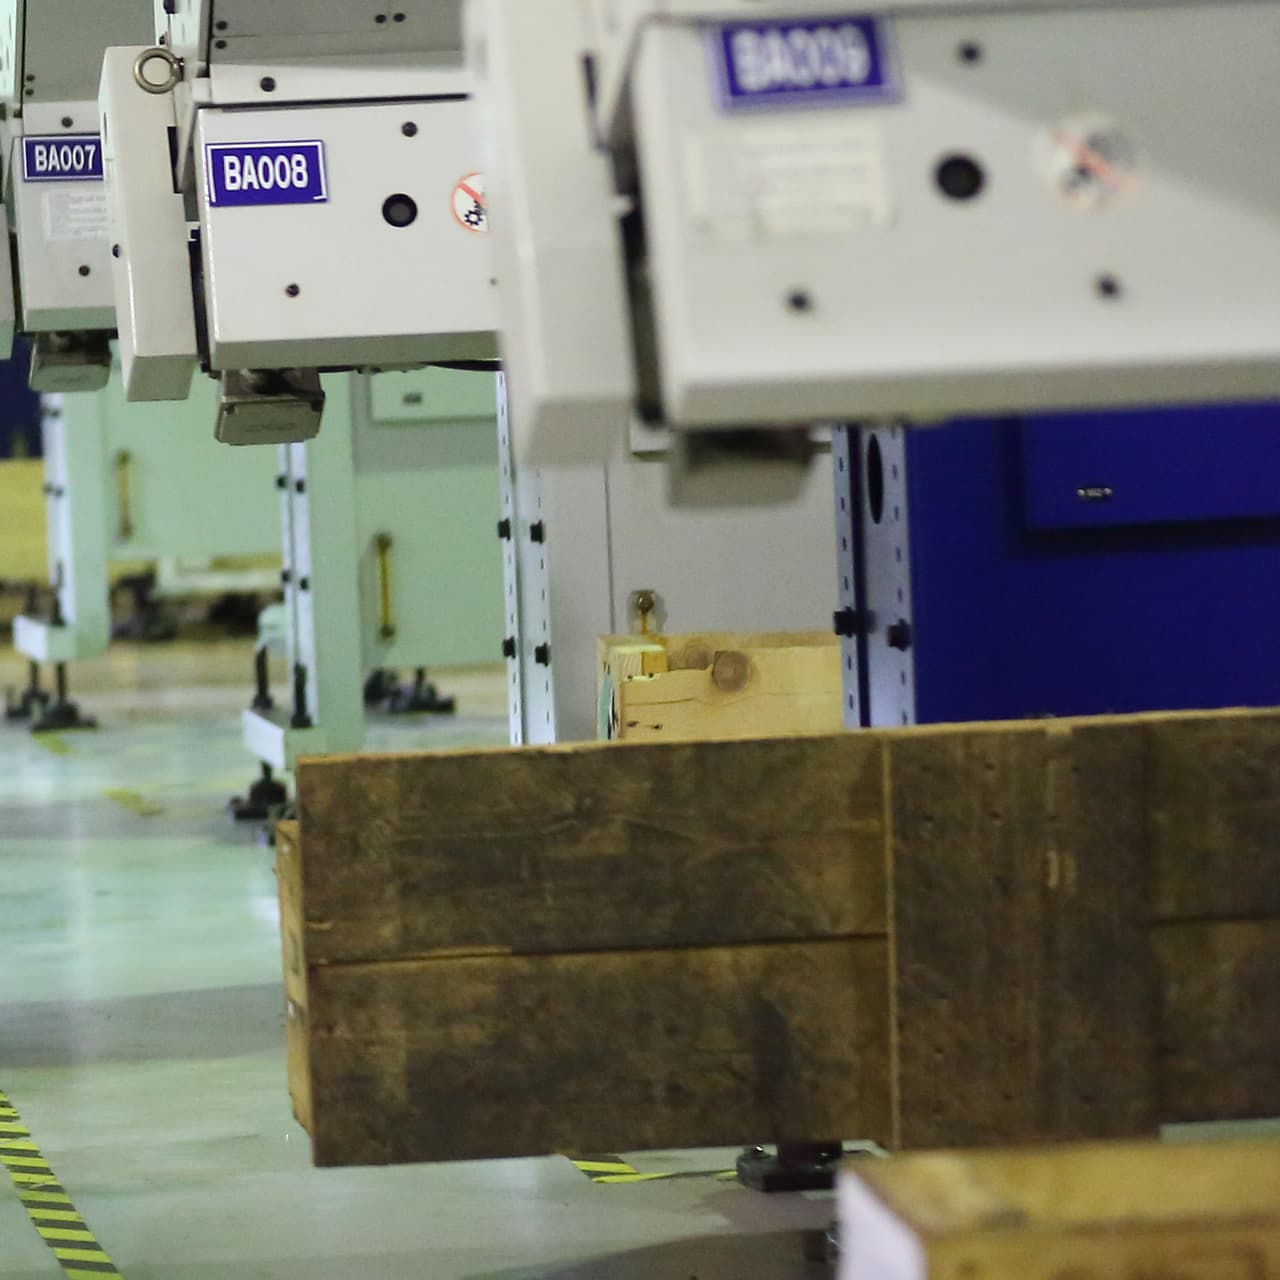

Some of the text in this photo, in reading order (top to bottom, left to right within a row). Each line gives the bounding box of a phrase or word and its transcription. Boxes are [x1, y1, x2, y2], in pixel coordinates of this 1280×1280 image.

[734, 23, 870, 91] BA009
[34, 144, 97, 172] BA007
[223, 154, 309, 191] BA008
